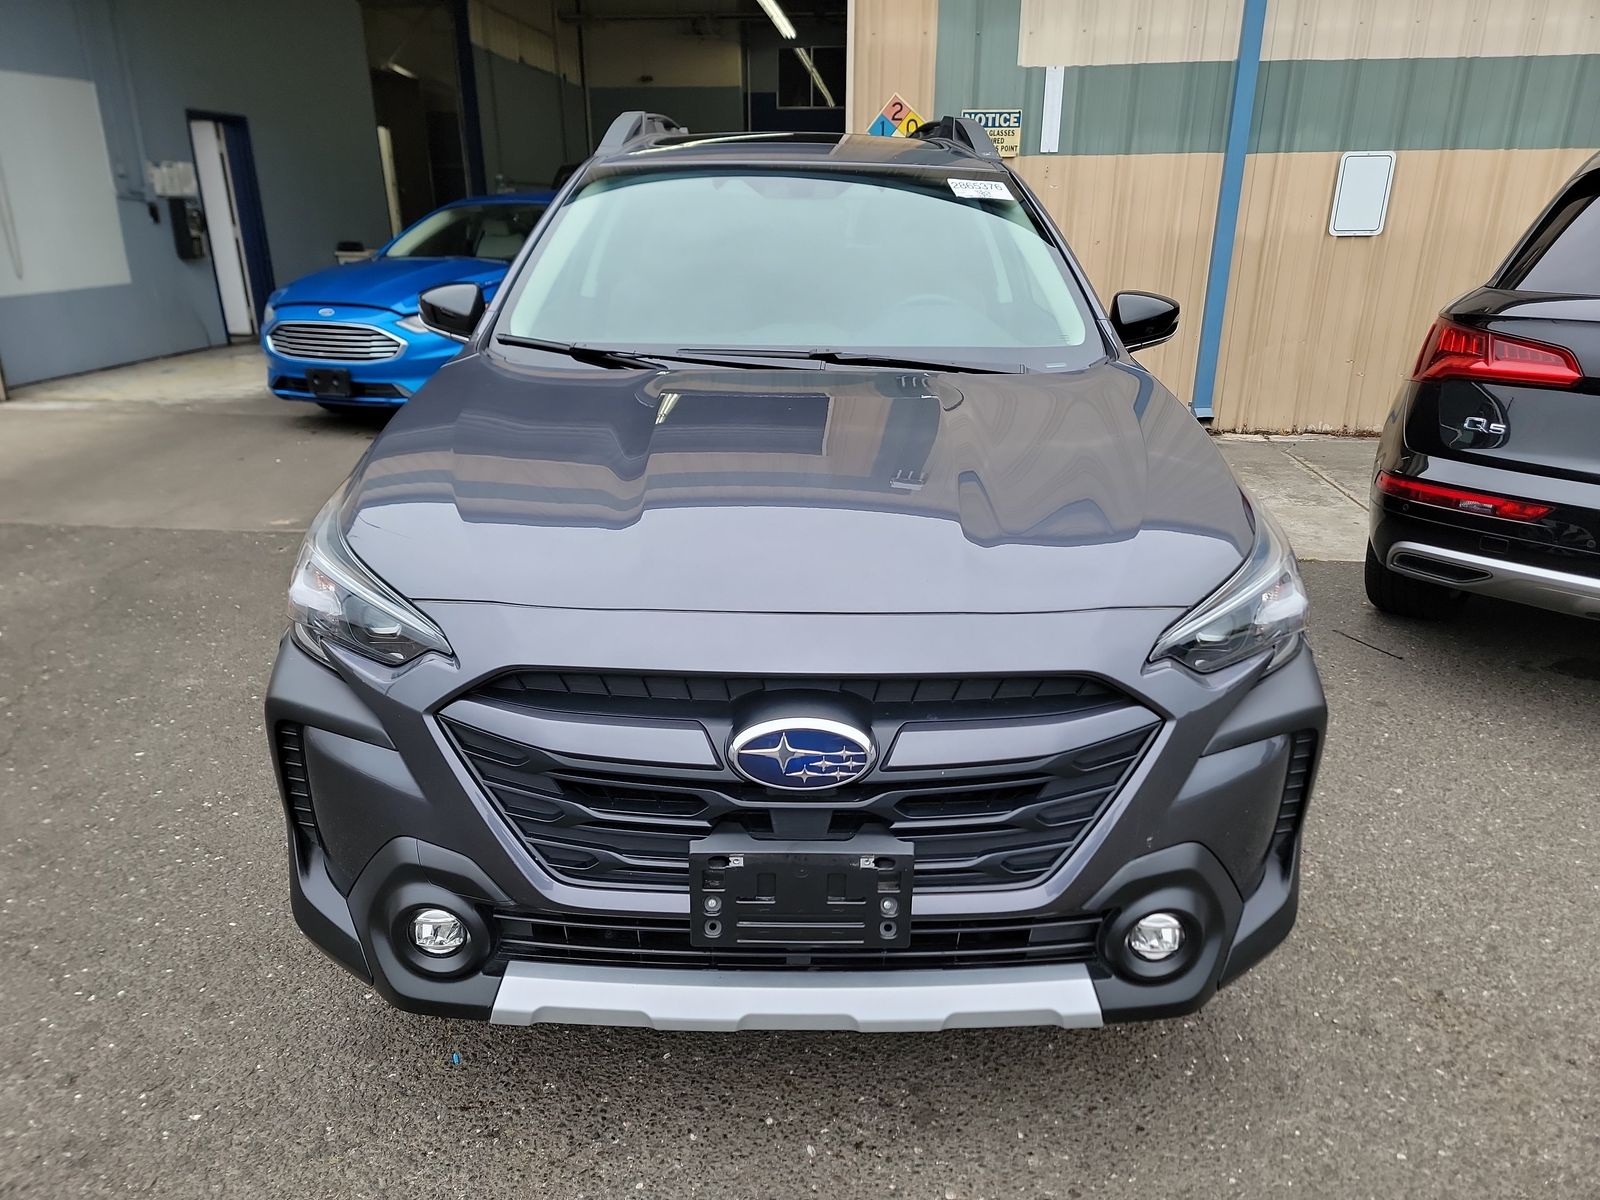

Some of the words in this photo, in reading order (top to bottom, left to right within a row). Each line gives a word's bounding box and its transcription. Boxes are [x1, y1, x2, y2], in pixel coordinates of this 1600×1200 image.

[891, 101, 903, 121] 2
[880, 121, 885, 136] 1
[989, 129, 1015, 137] GLASSES
[1463, 416, 1506, 434] Q5
